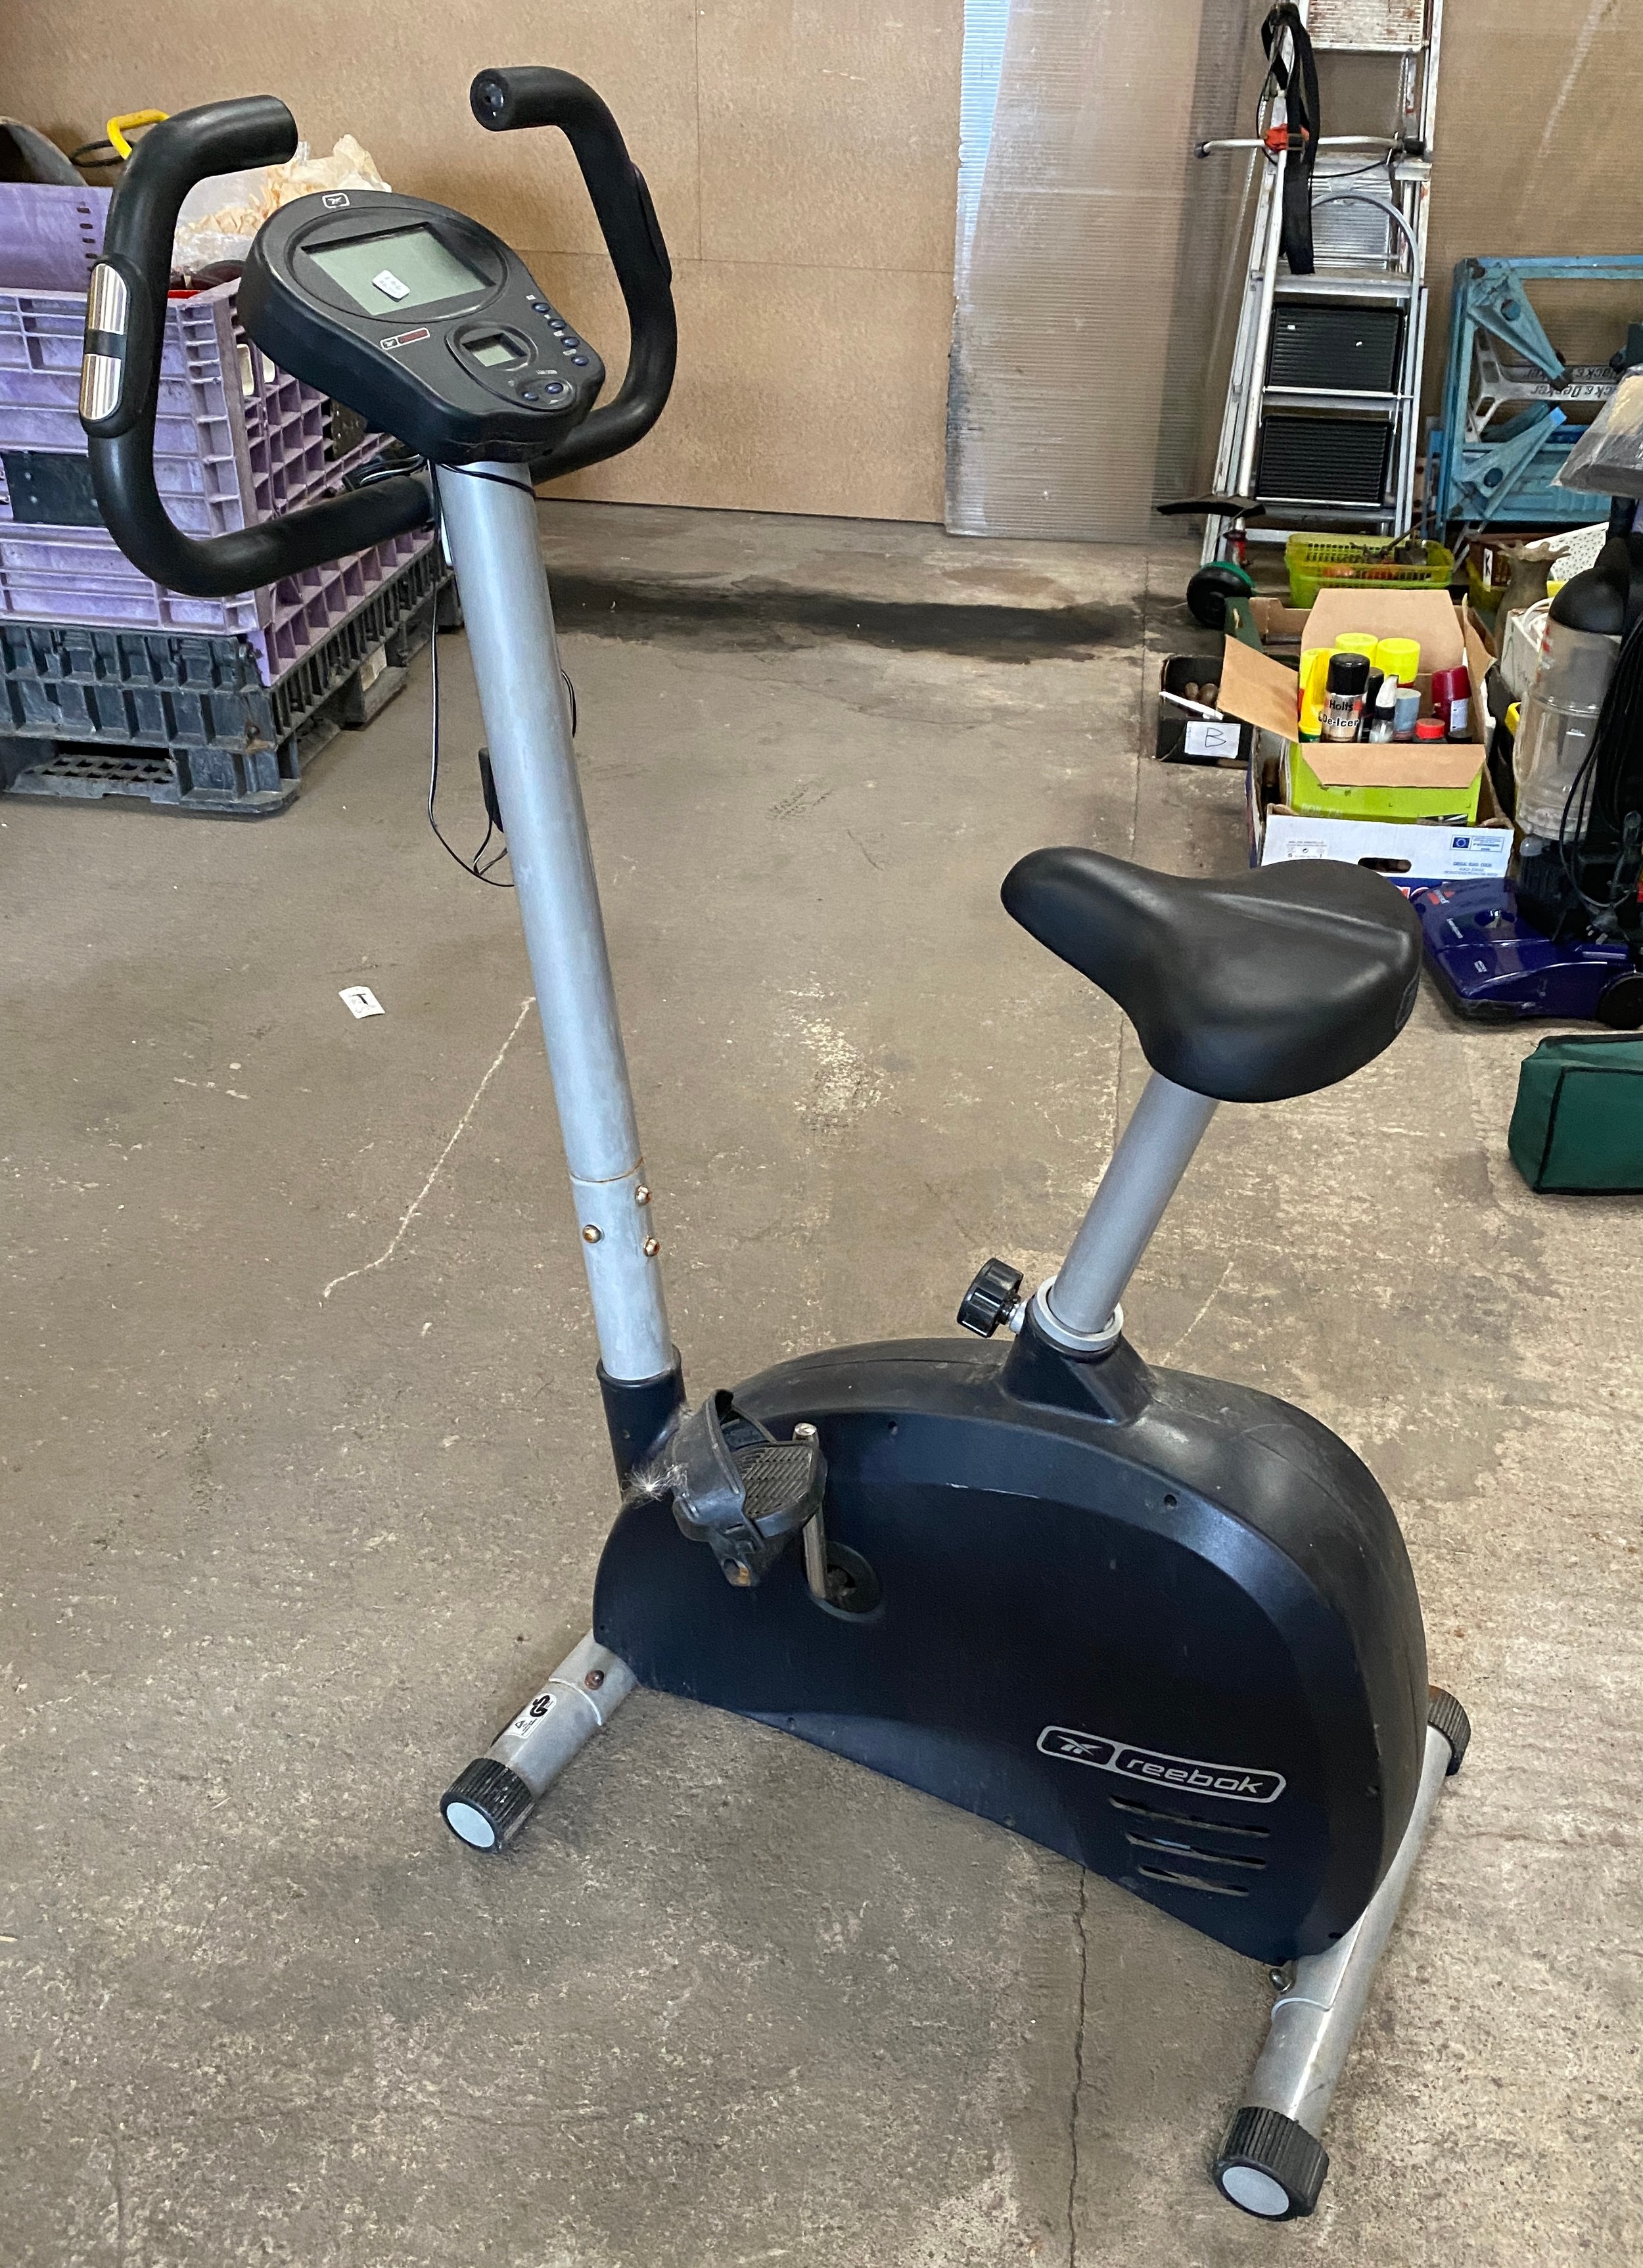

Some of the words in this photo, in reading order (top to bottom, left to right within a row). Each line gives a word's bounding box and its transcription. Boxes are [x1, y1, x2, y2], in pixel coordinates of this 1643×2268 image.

[1330, 699, 1354, 711] Holts
[1205, 727, 1226, 748] B
[348, 993, 369, 1005] T
[1126, 1758, 1264, 1794] reebok
